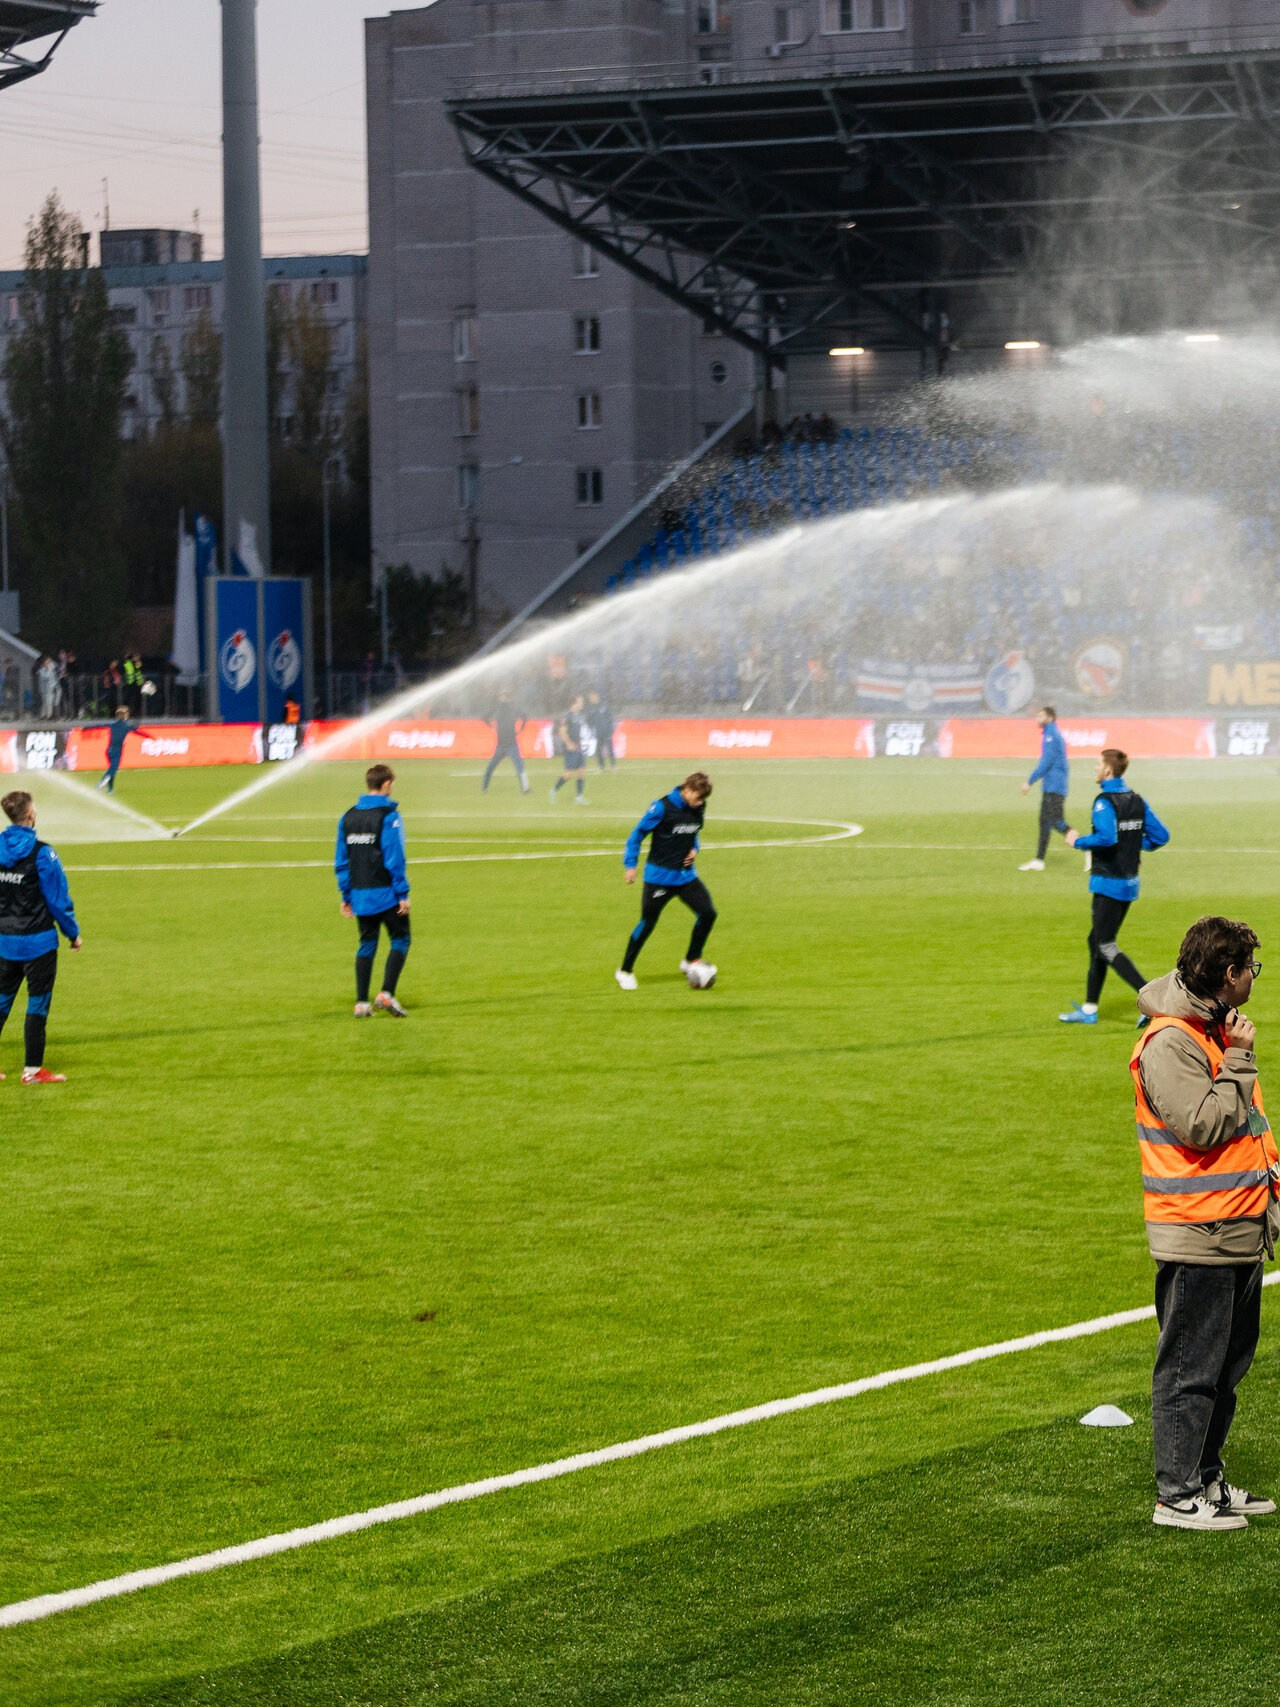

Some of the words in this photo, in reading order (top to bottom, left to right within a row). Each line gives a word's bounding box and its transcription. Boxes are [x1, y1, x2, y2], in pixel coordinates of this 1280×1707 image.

[885, 722, 925, 739] FON
[1228, 721, 1270, 738] FON
[25, 731, 57, 752] FON
[268, 741, 298, 760] BET
[885, 737, 926, 755] BET
[1228, 737, 1271, 756] BET
[26, 749, 58, 769] BET
